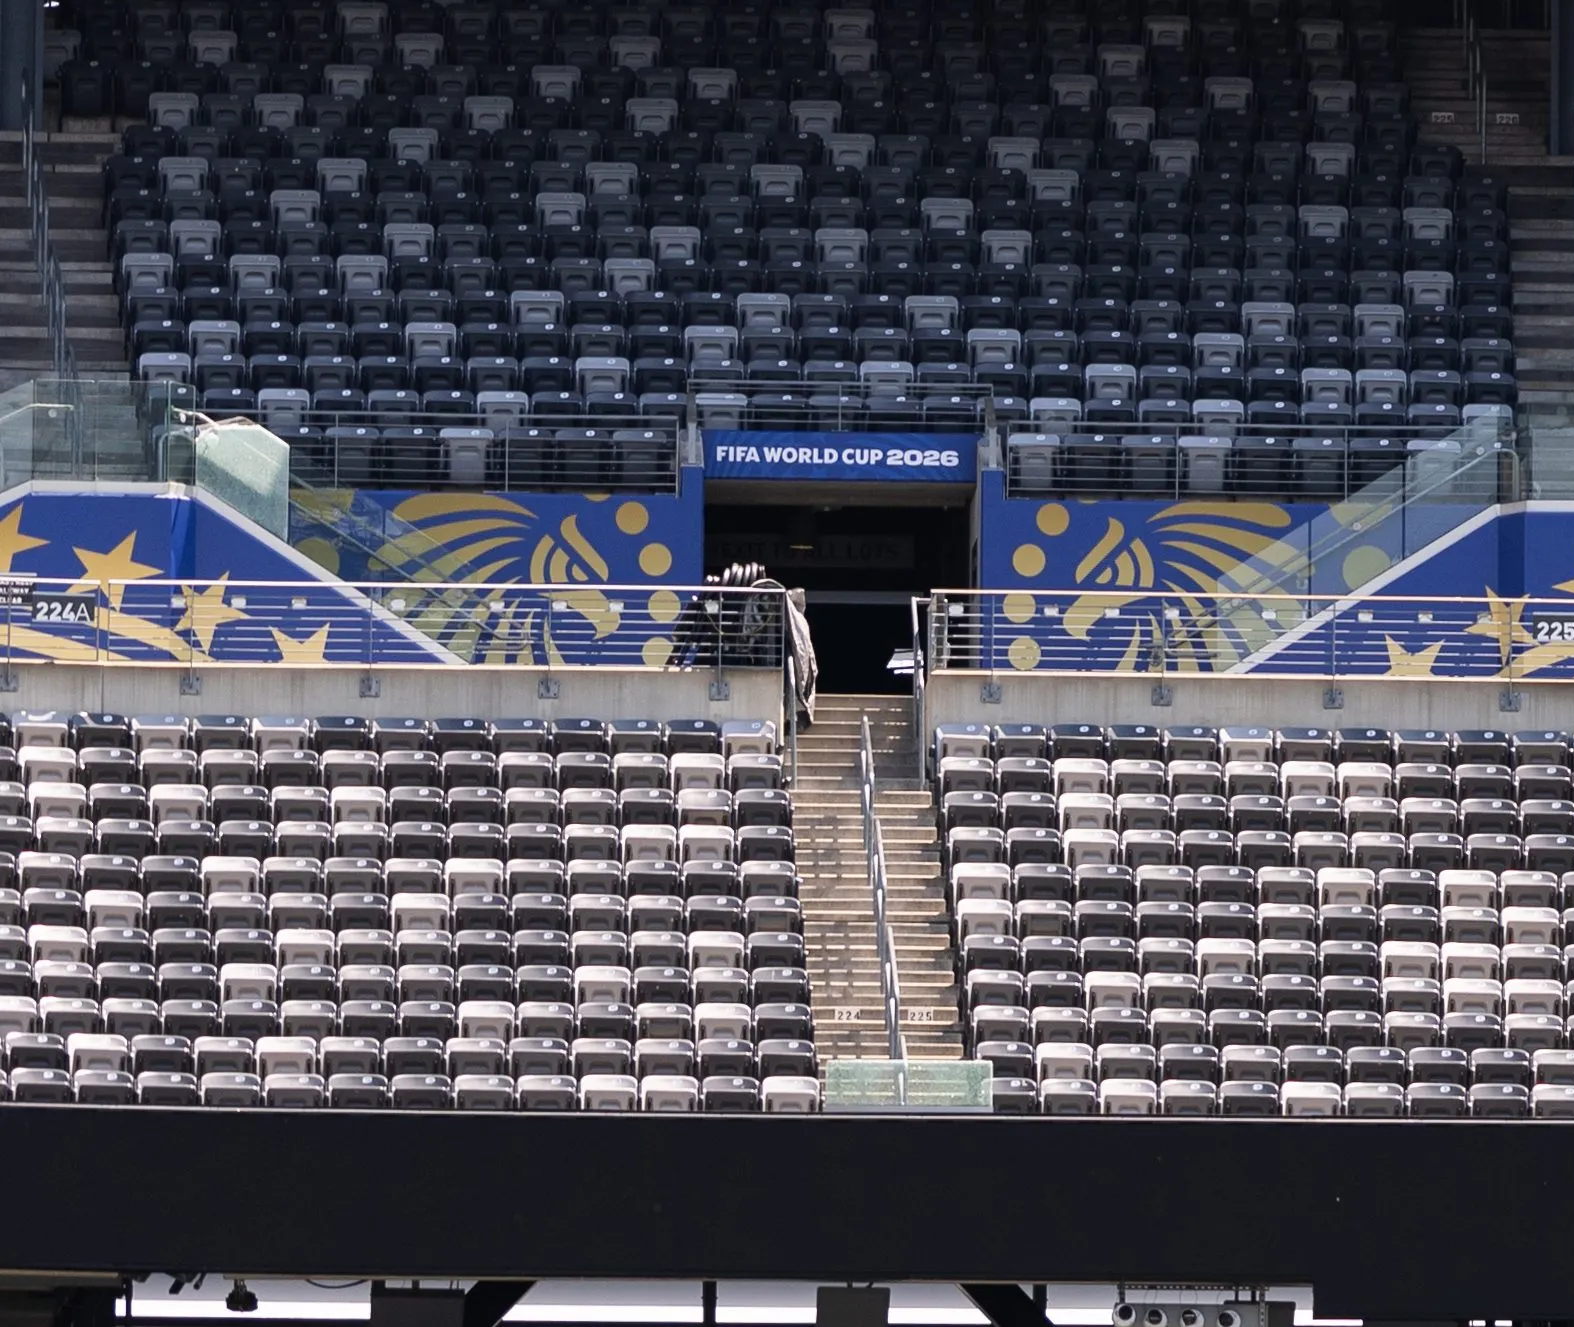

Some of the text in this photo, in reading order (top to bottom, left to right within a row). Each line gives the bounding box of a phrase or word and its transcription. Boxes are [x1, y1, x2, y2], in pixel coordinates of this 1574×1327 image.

[716, 446, 960, 467] FIFA WORLD CUP 2026
[36, 601, 91, 622] 224A
[838, 1010, 860, 1021] 224
[910, 1011, 932, 1021] 225
